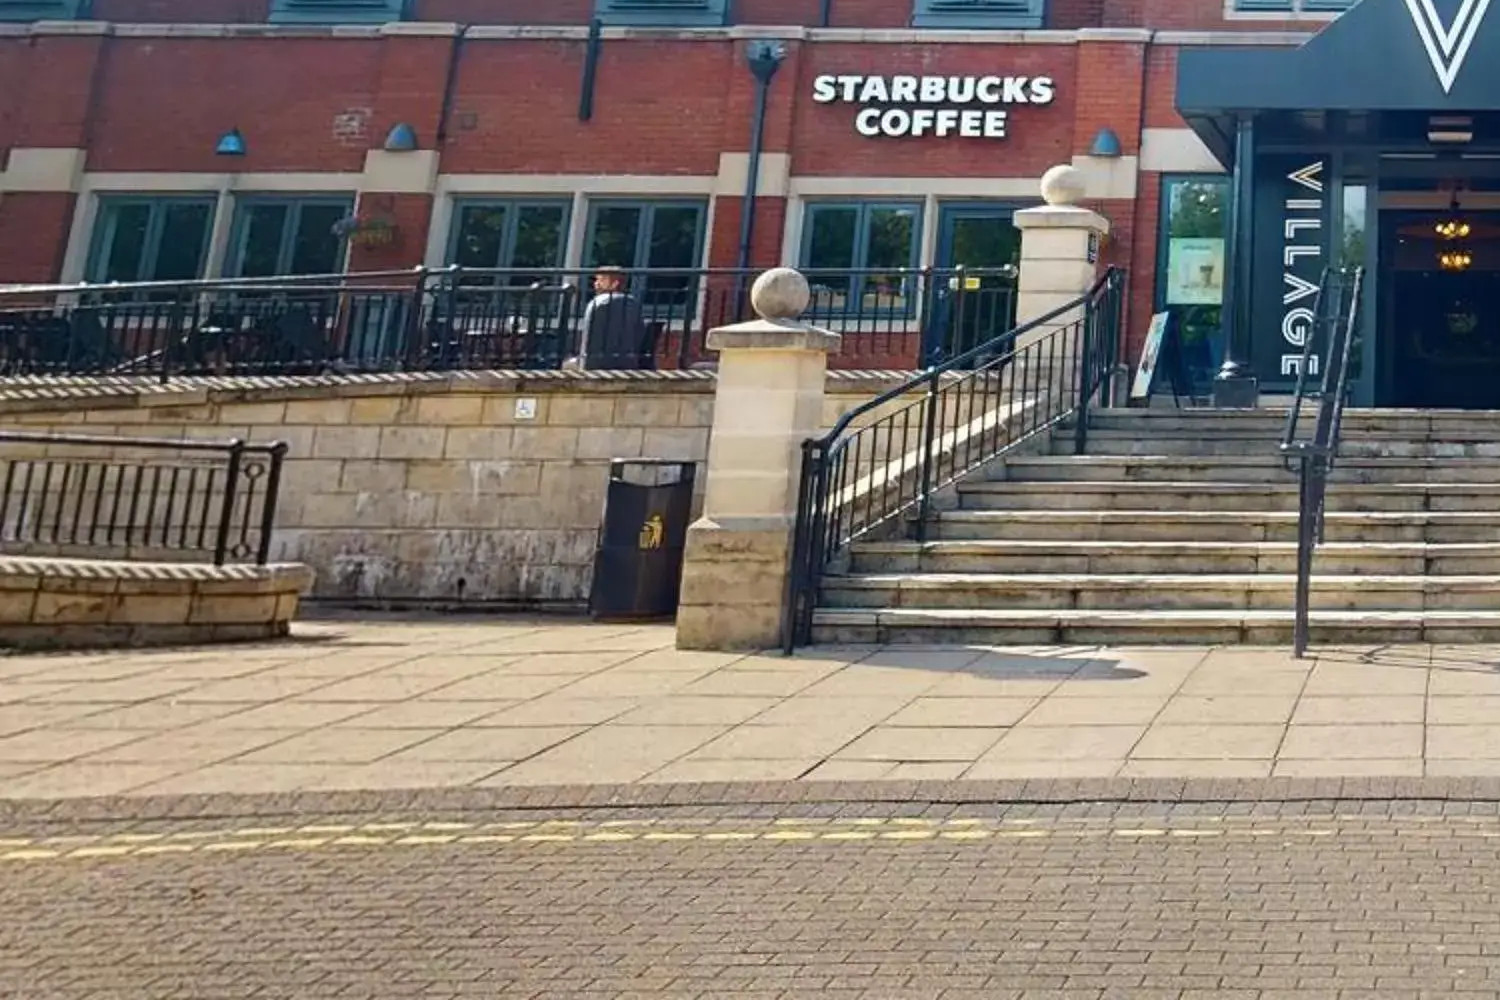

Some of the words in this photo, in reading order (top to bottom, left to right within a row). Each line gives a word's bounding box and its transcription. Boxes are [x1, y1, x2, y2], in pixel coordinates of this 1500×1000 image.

[812, 74, 1055, 104] STARBUCKS
[855, 107, 1007, 138] COFFEE
[1281, 161, 1323, 376] VILLAGE
